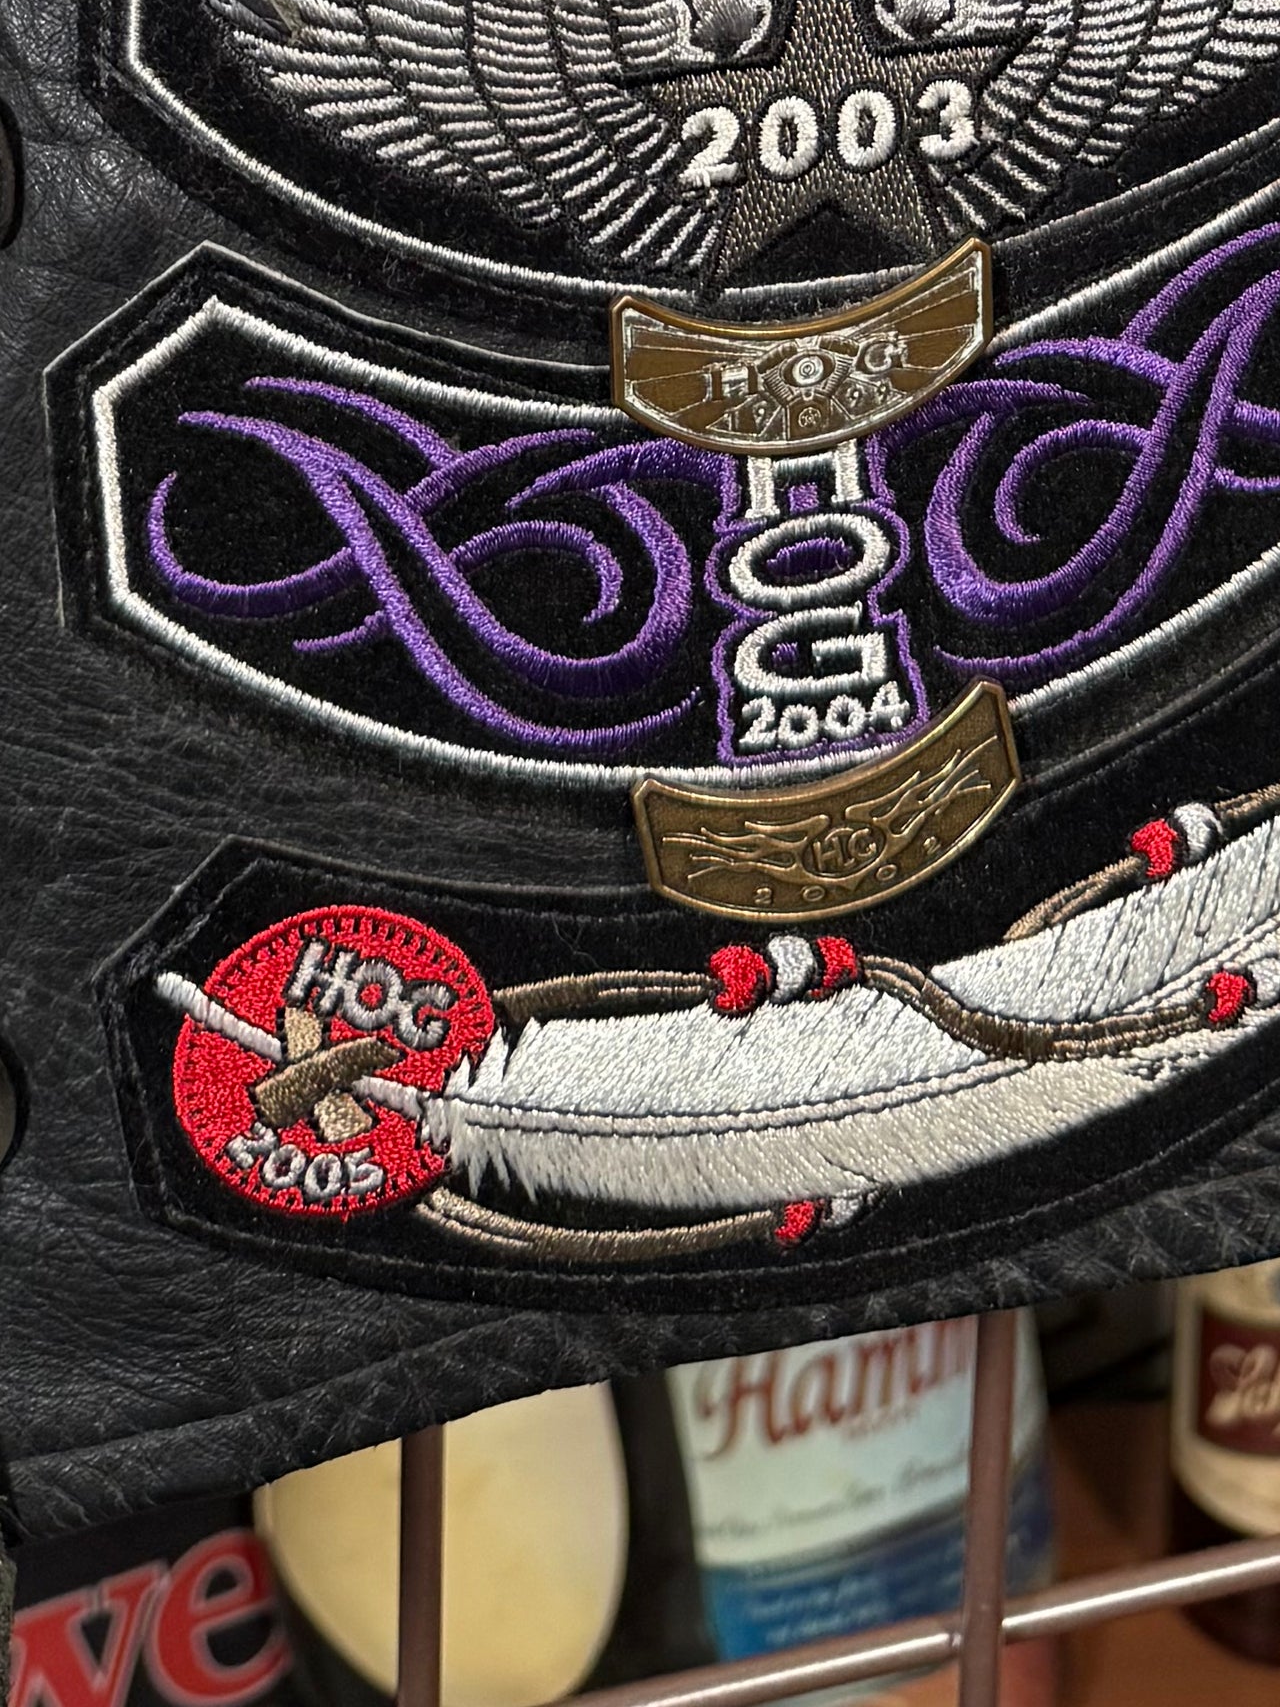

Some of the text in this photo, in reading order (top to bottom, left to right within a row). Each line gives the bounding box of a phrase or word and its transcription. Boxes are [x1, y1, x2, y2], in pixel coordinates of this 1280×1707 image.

[678, 75, 982, 188] 2003
[737, 680, 912, 748] 2004
[285, 938, 458, 1051] HOG
[224, 1121, 387, 1203] 2005
